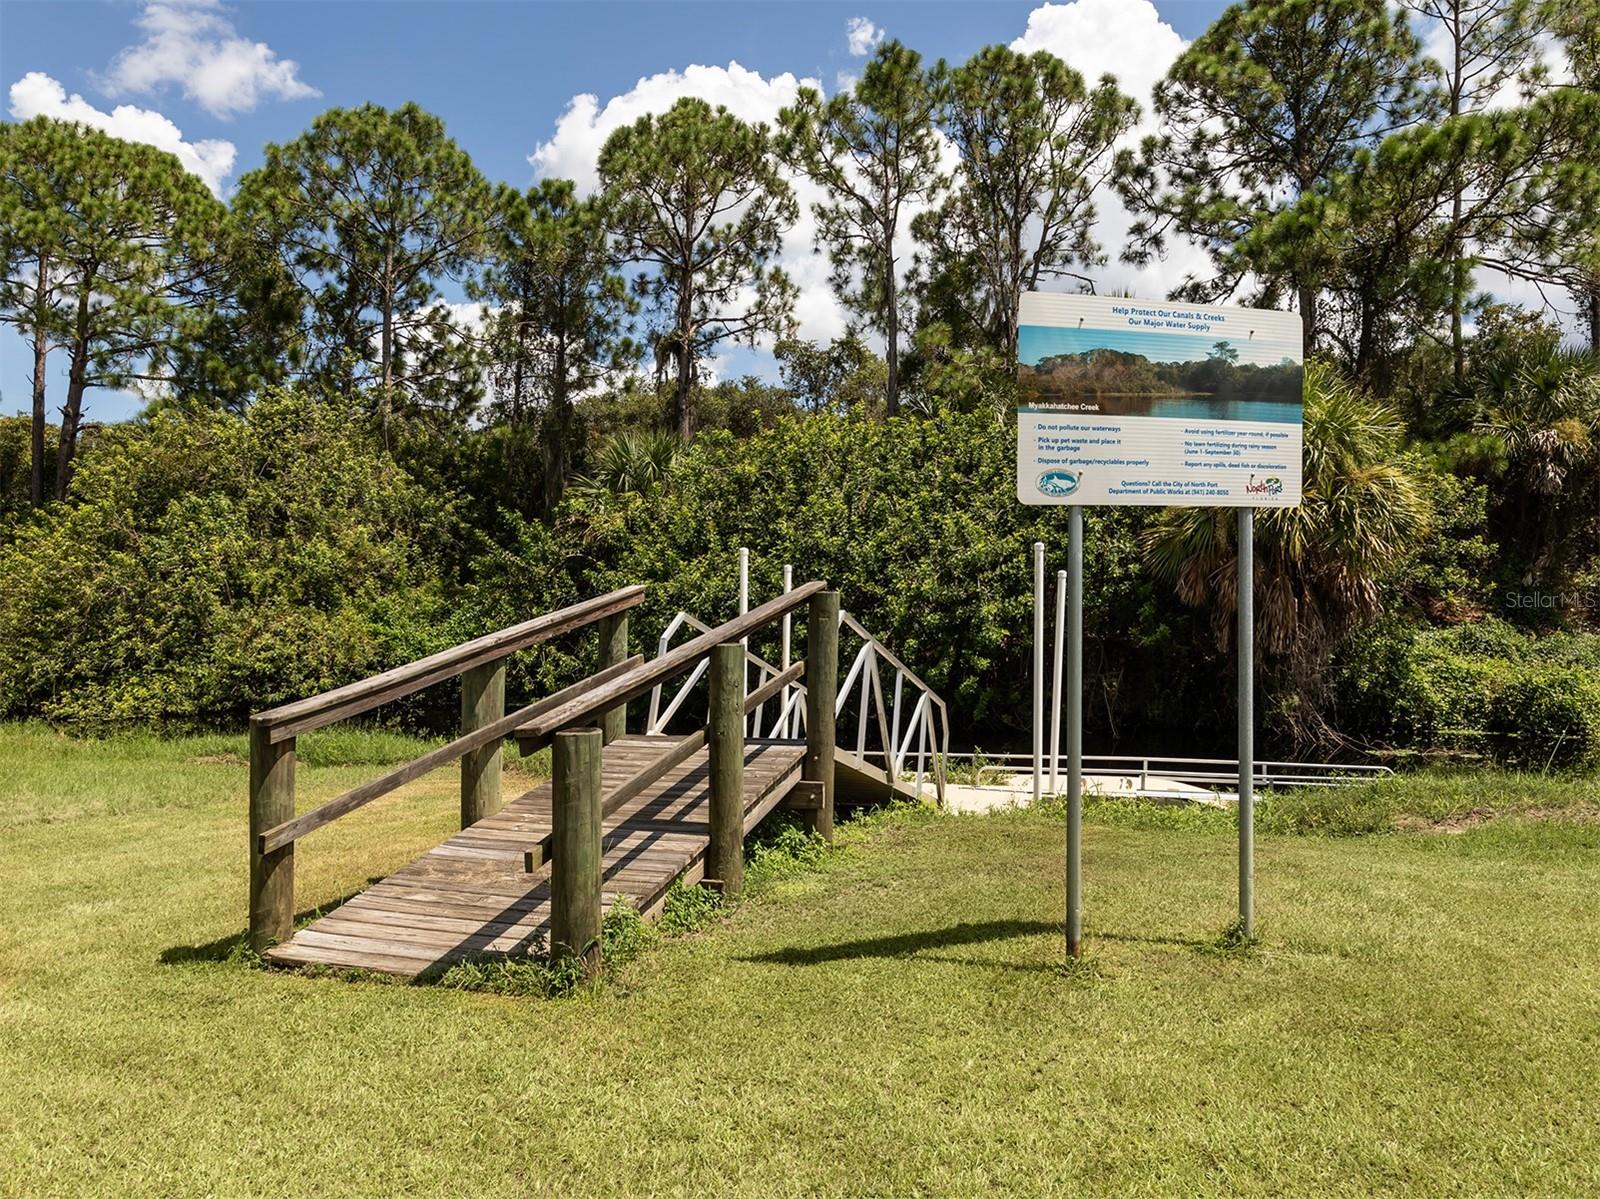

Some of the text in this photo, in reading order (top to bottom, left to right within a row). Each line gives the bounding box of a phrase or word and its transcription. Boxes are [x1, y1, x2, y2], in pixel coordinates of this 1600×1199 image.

[1113, 307, 1128, 316] Help
[1131, 308, 1156, 316] Protect
[1172, 311, 1193, 319] Canals
[1144, 319, 1163, 328] Major
[1188, 322, 1210, 332] Supply
[1028, 402, 1079, 410] Myakkahatchee
